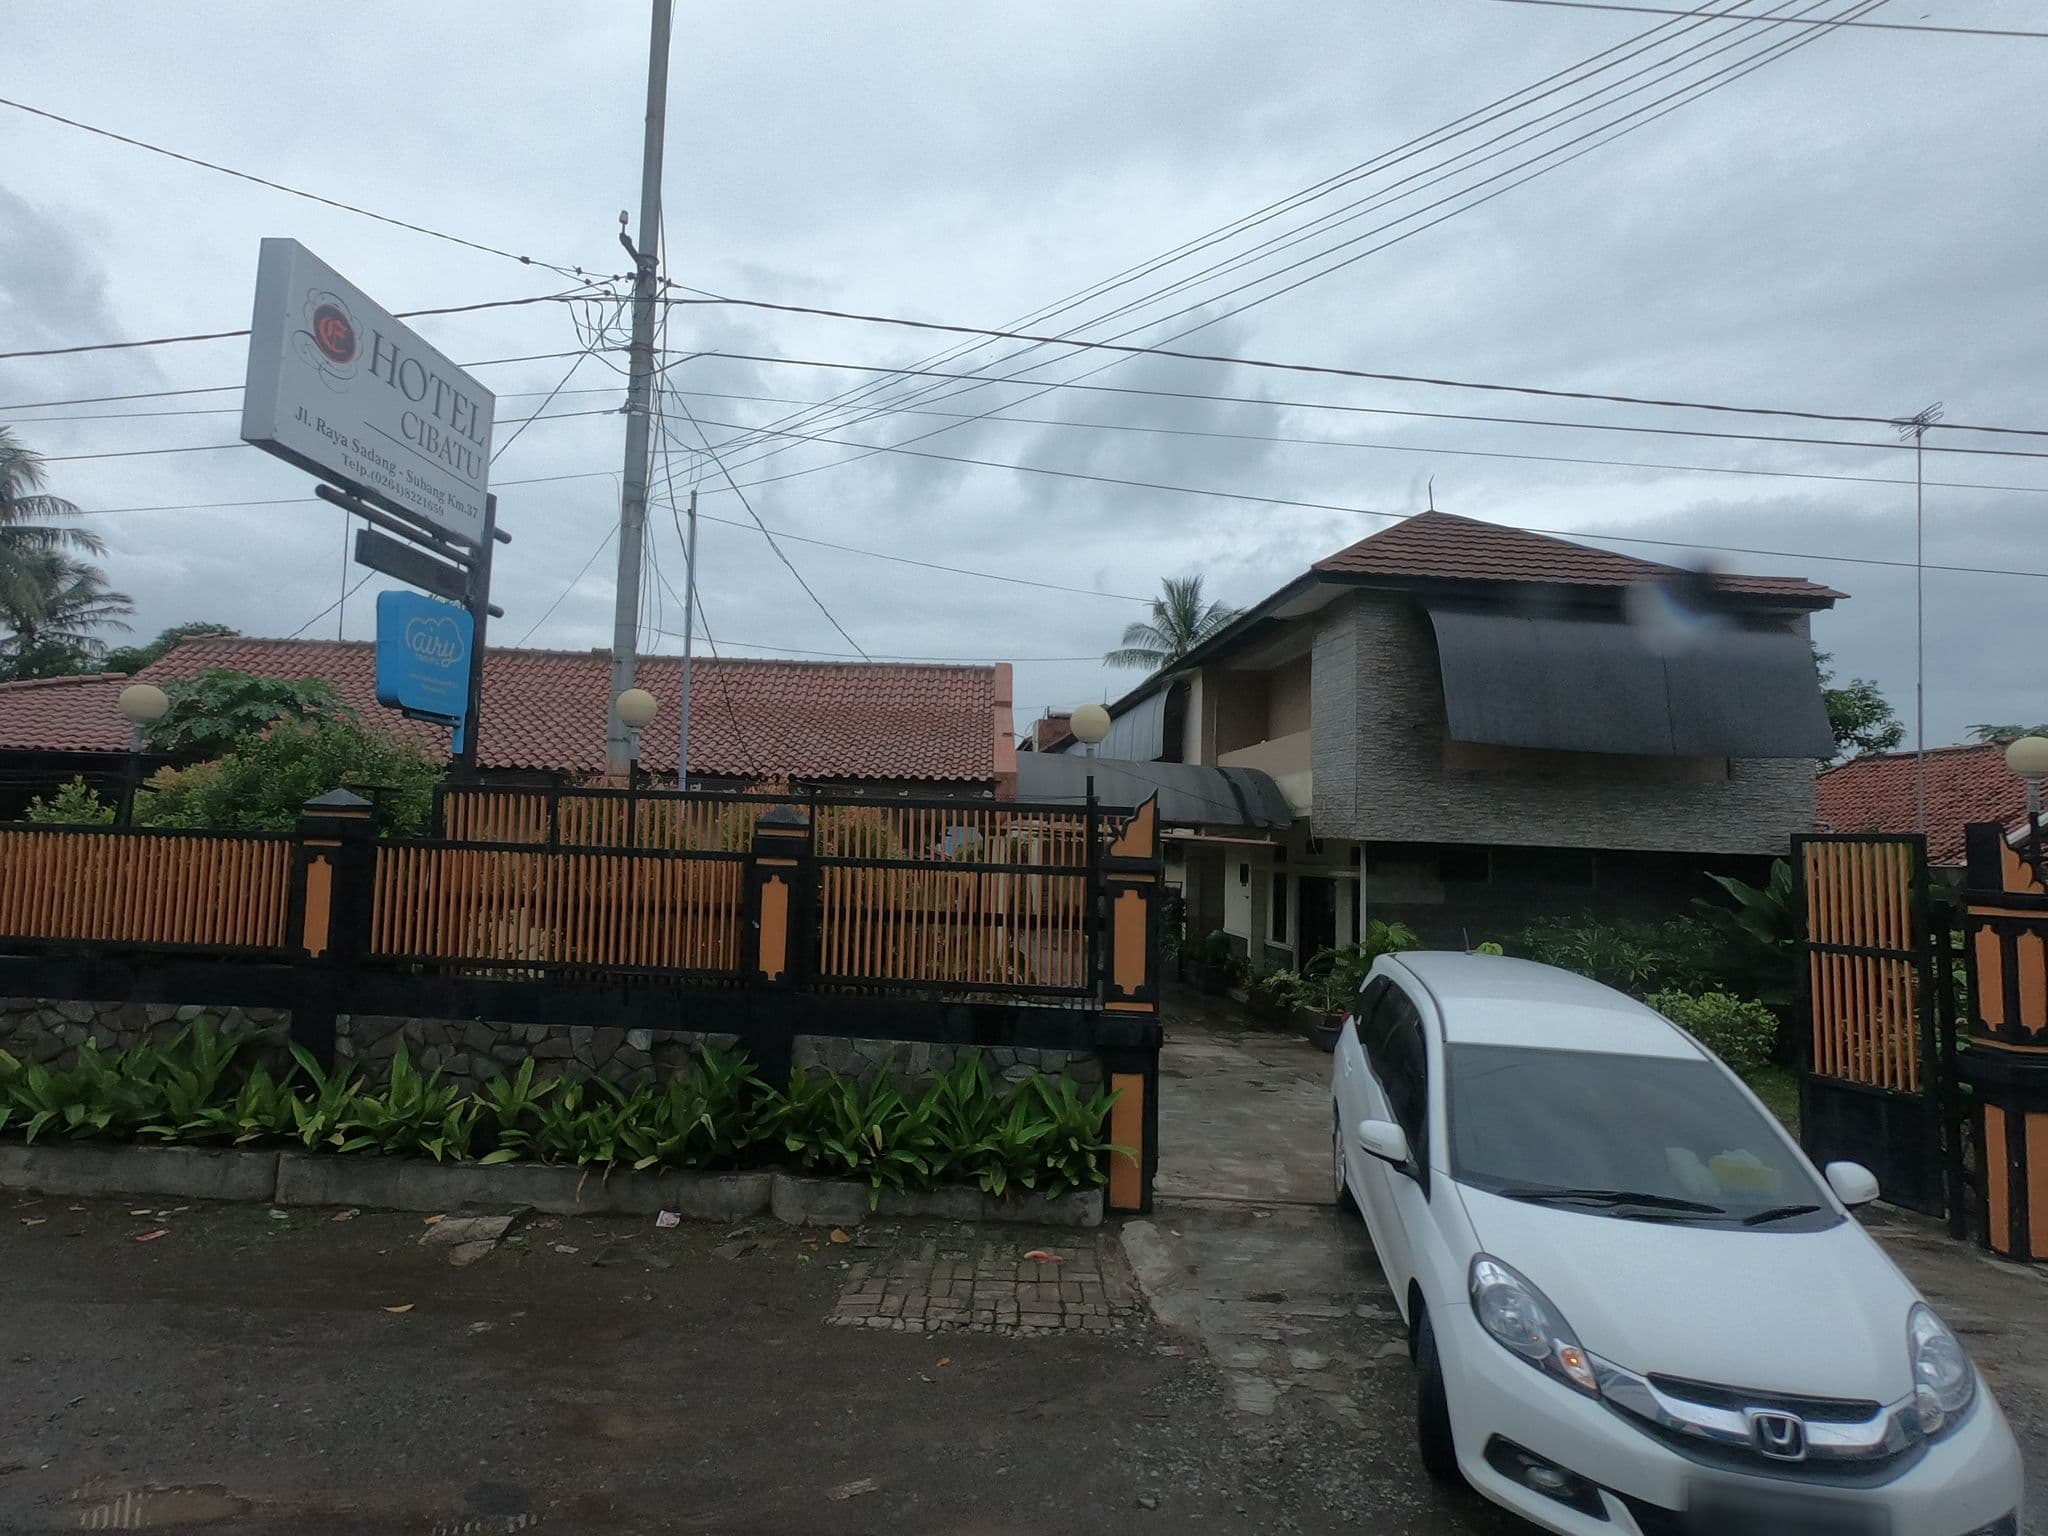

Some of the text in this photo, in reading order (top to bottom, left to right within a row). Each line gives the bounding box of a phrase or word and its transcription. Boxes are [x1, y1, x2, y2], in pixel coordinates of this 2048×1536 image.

[368, 329, 486, 448] HOTEL
[296, 406, 311, 427] Jl.
[317, 417, 348, 447] Raya
[352, 438, 396, 477] Sadang
[405, 469, 445, 504] Subang
[448, 494, 478, 519] Km.37
[401, 411, 482, 480] CIBATU
